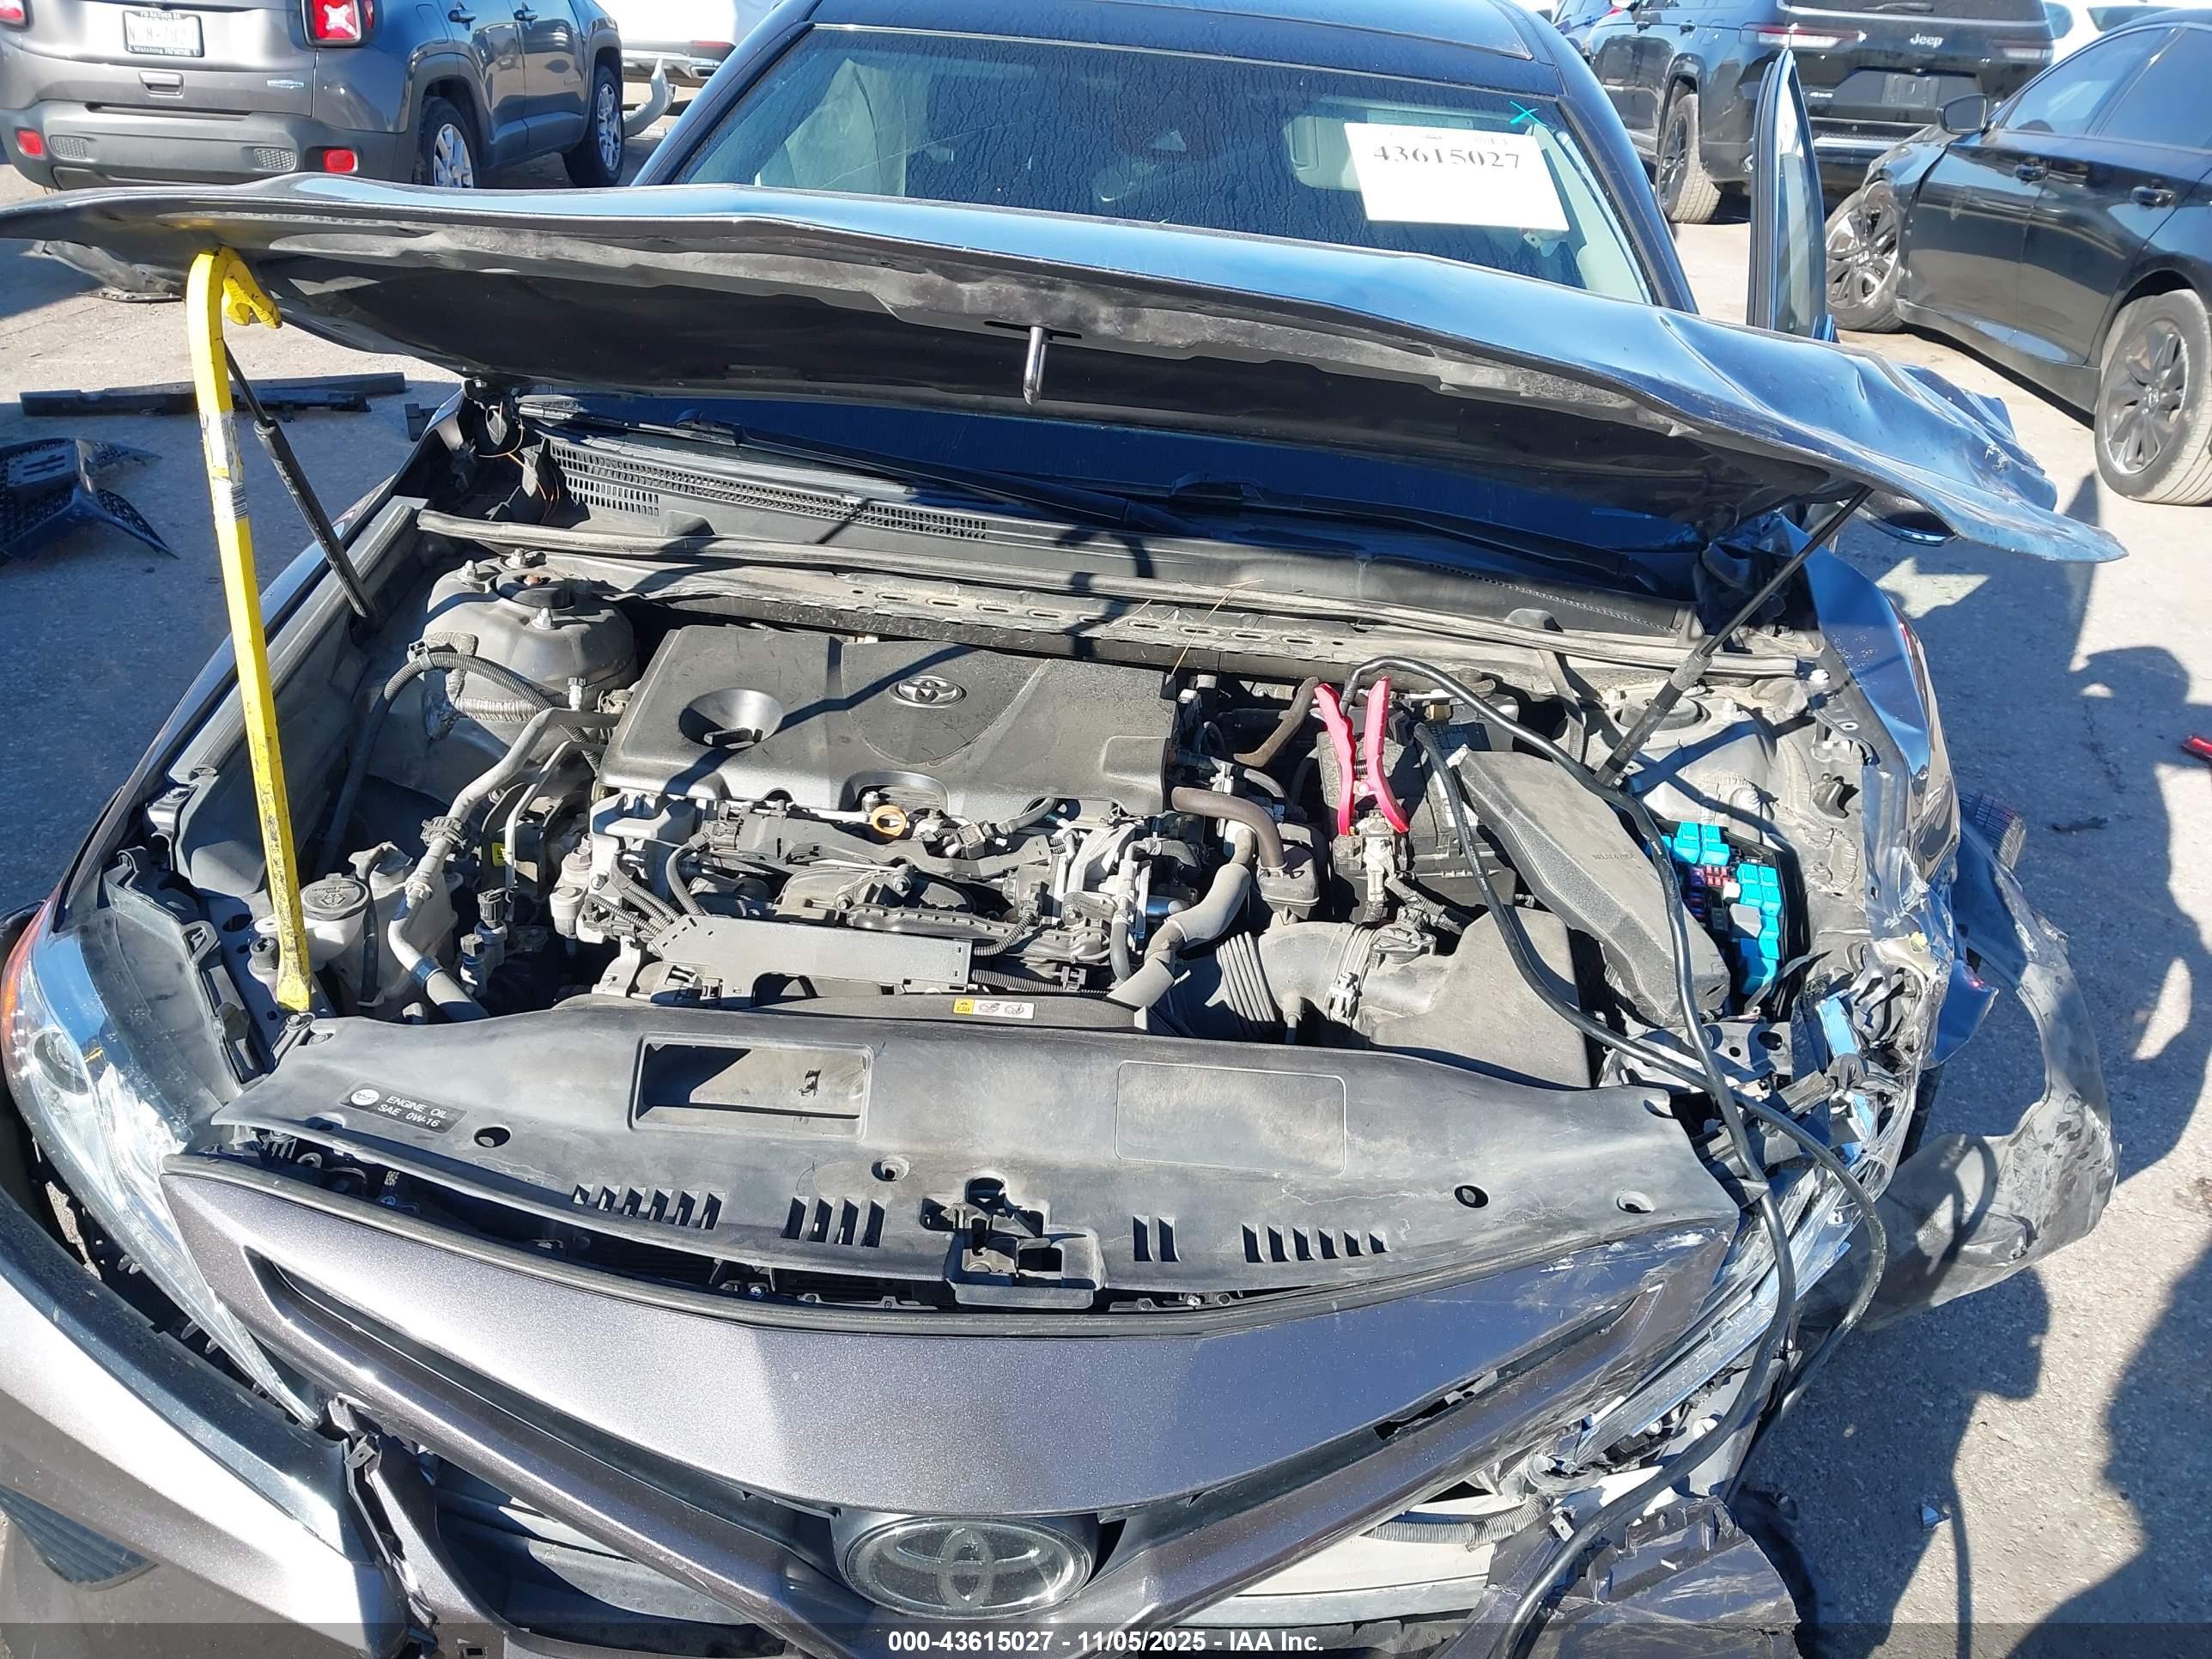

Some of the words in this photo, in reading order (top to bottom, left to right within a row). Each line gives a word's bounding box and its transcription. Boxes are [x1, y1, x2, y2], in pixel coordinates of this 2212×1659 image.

[1910, 33, 1944, 48] Jeep
[1373, 145, 1519, 169] 43615027
[377, 1104, 402, 1116] SAE
[405, 1112, 441, 1127] 0W-16
[386, 1096, 428, 1113] ENGINE
[429, 1108, 447, 1119] OIL
